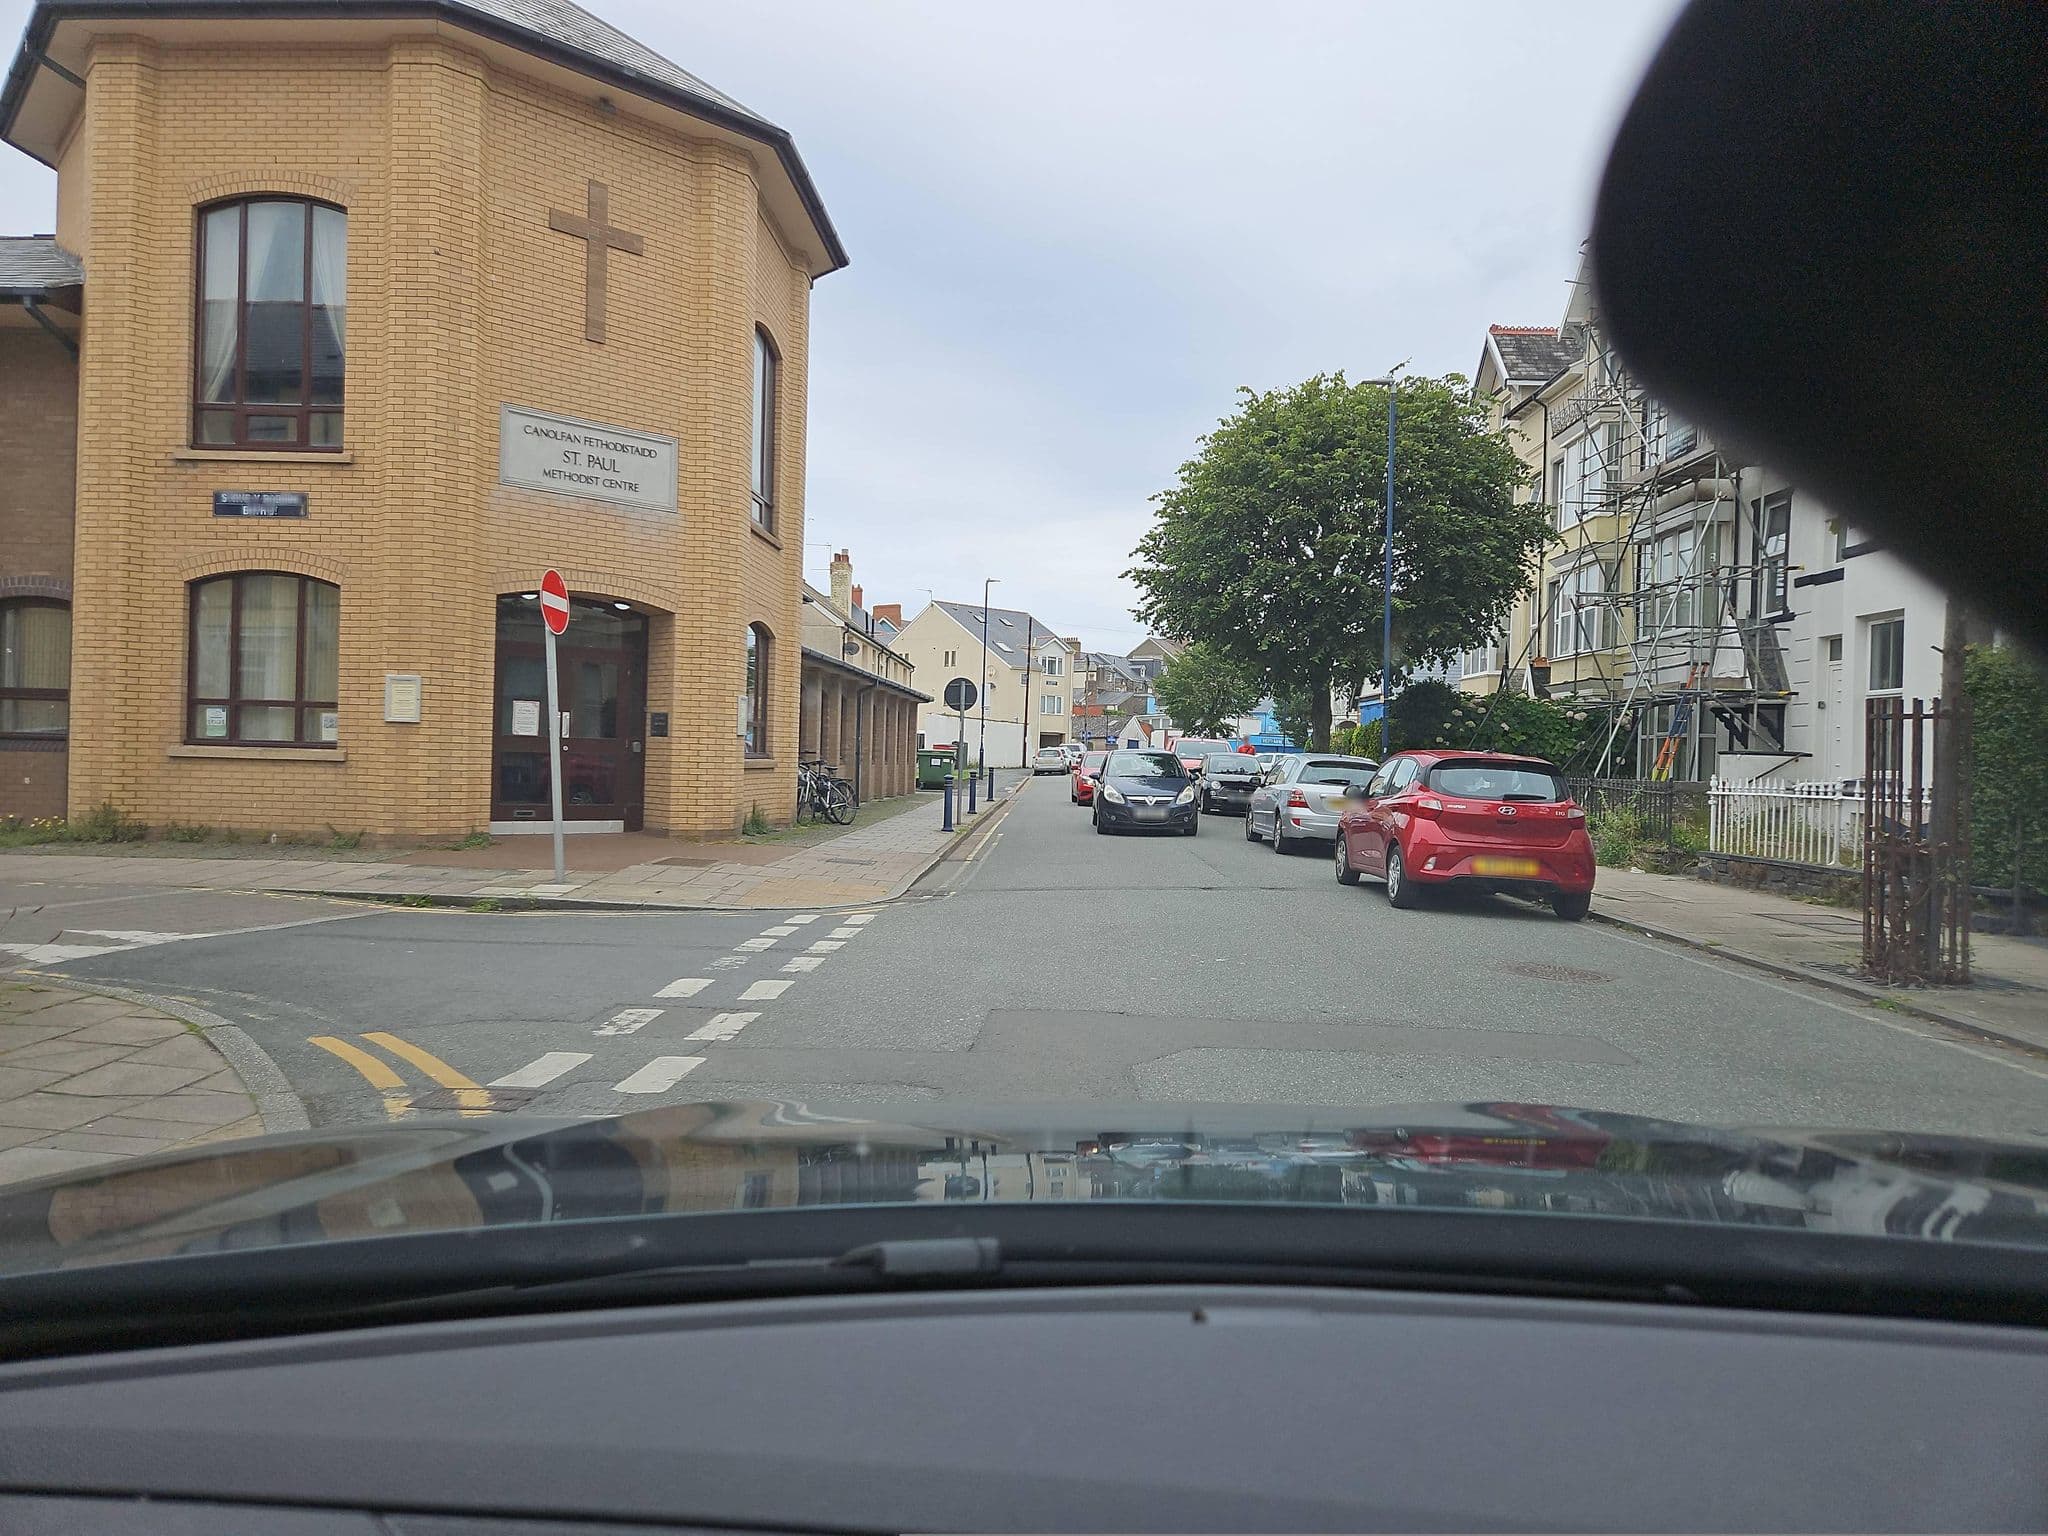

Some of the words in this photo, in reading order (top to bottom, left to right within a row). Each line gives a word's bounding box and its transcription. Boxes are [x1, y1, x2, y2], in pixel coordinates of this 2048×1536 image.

[524, 425, 581, 444] CANOLFAN
[584, 436, 658, 459] FETHODISTAIDD
[563, 450, 582, 467] ST.
[588, 454, 621, 473] PAUL
[543, 468, 600, 486] METHODIST
[602, 478, 640, 493] CENTRE
